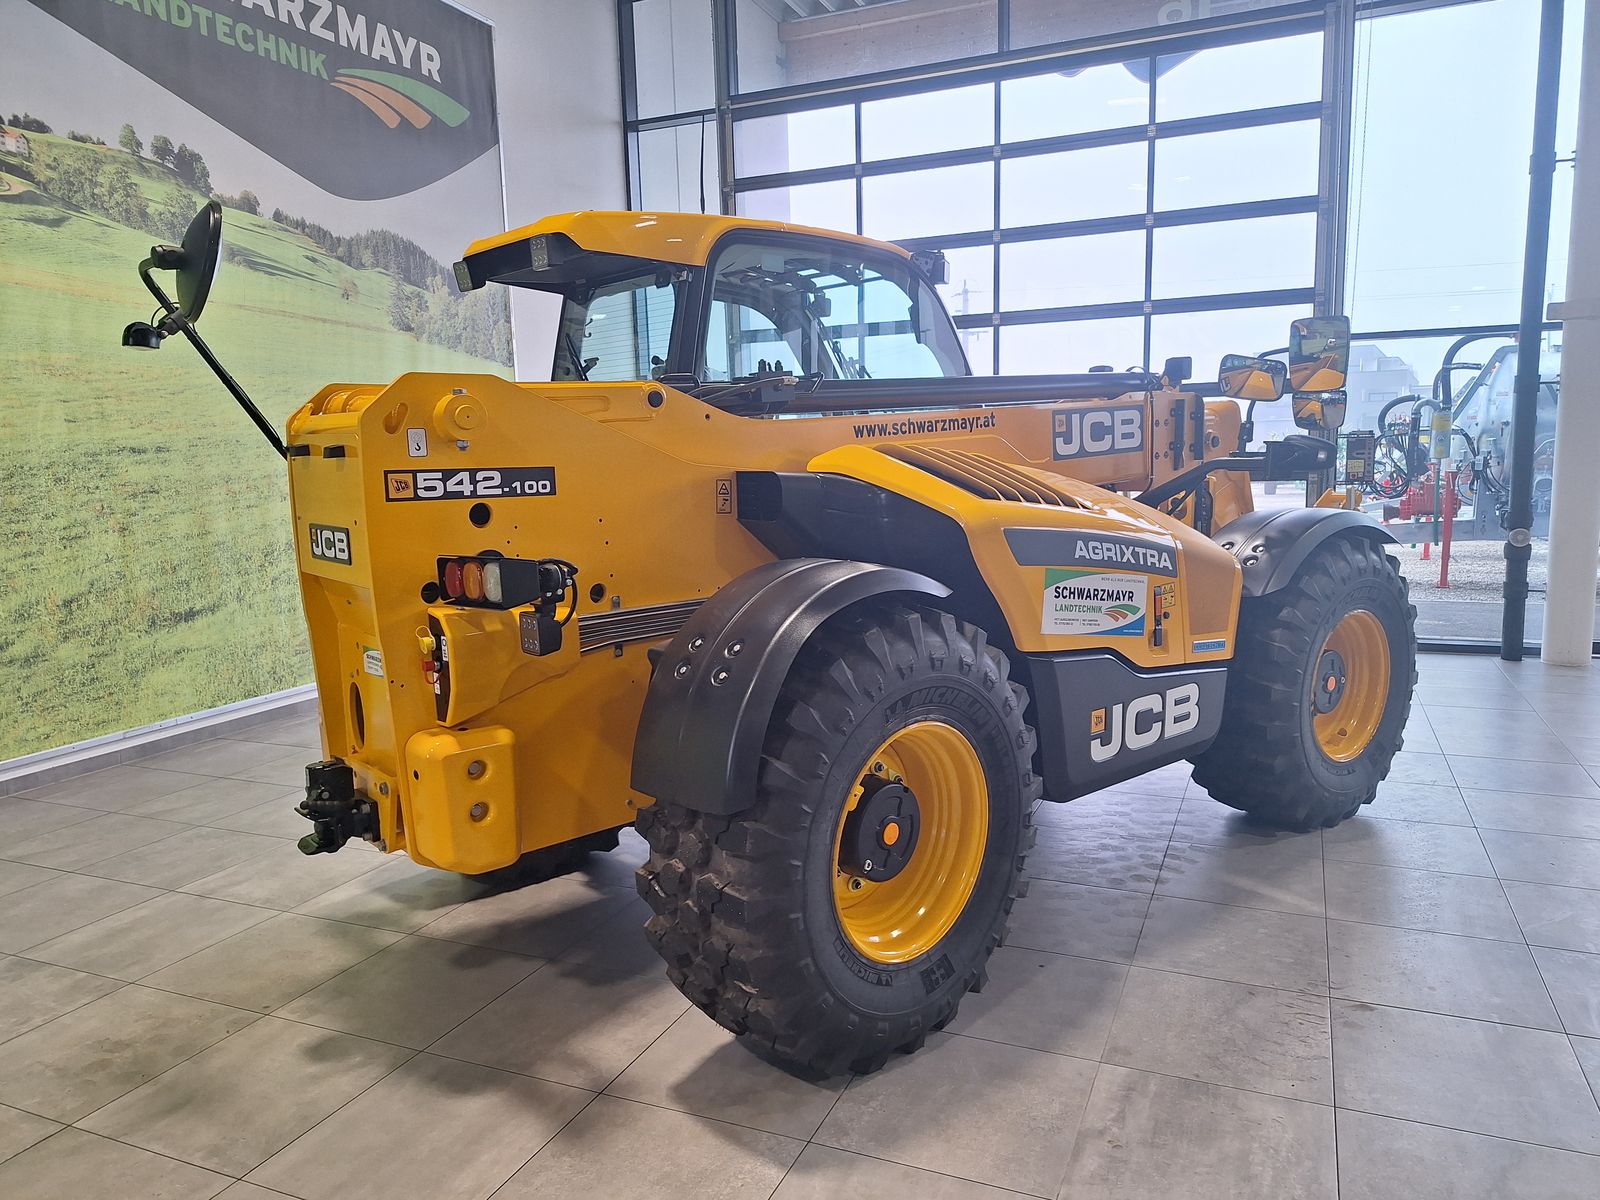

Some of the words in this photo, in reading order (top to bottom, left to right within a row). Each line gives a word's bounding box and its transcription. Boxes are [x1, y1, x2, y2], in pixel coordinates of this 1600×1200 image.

[852, 411, 996, 439] www.schwarzmayr.at
[1055, 409, 1142, 456] JCB
[416, 470, 551, 498] 542-100
[311, 528, 349, 560] JCB
[1074, 540, 1173, 570] AGRIXTRA
[1054, 585, 1134, 602] SCHWARZMAYR
[1054, 603, 1103, 614] LANDTECHNIK
[1090, 682, 1200, 763] JCB
